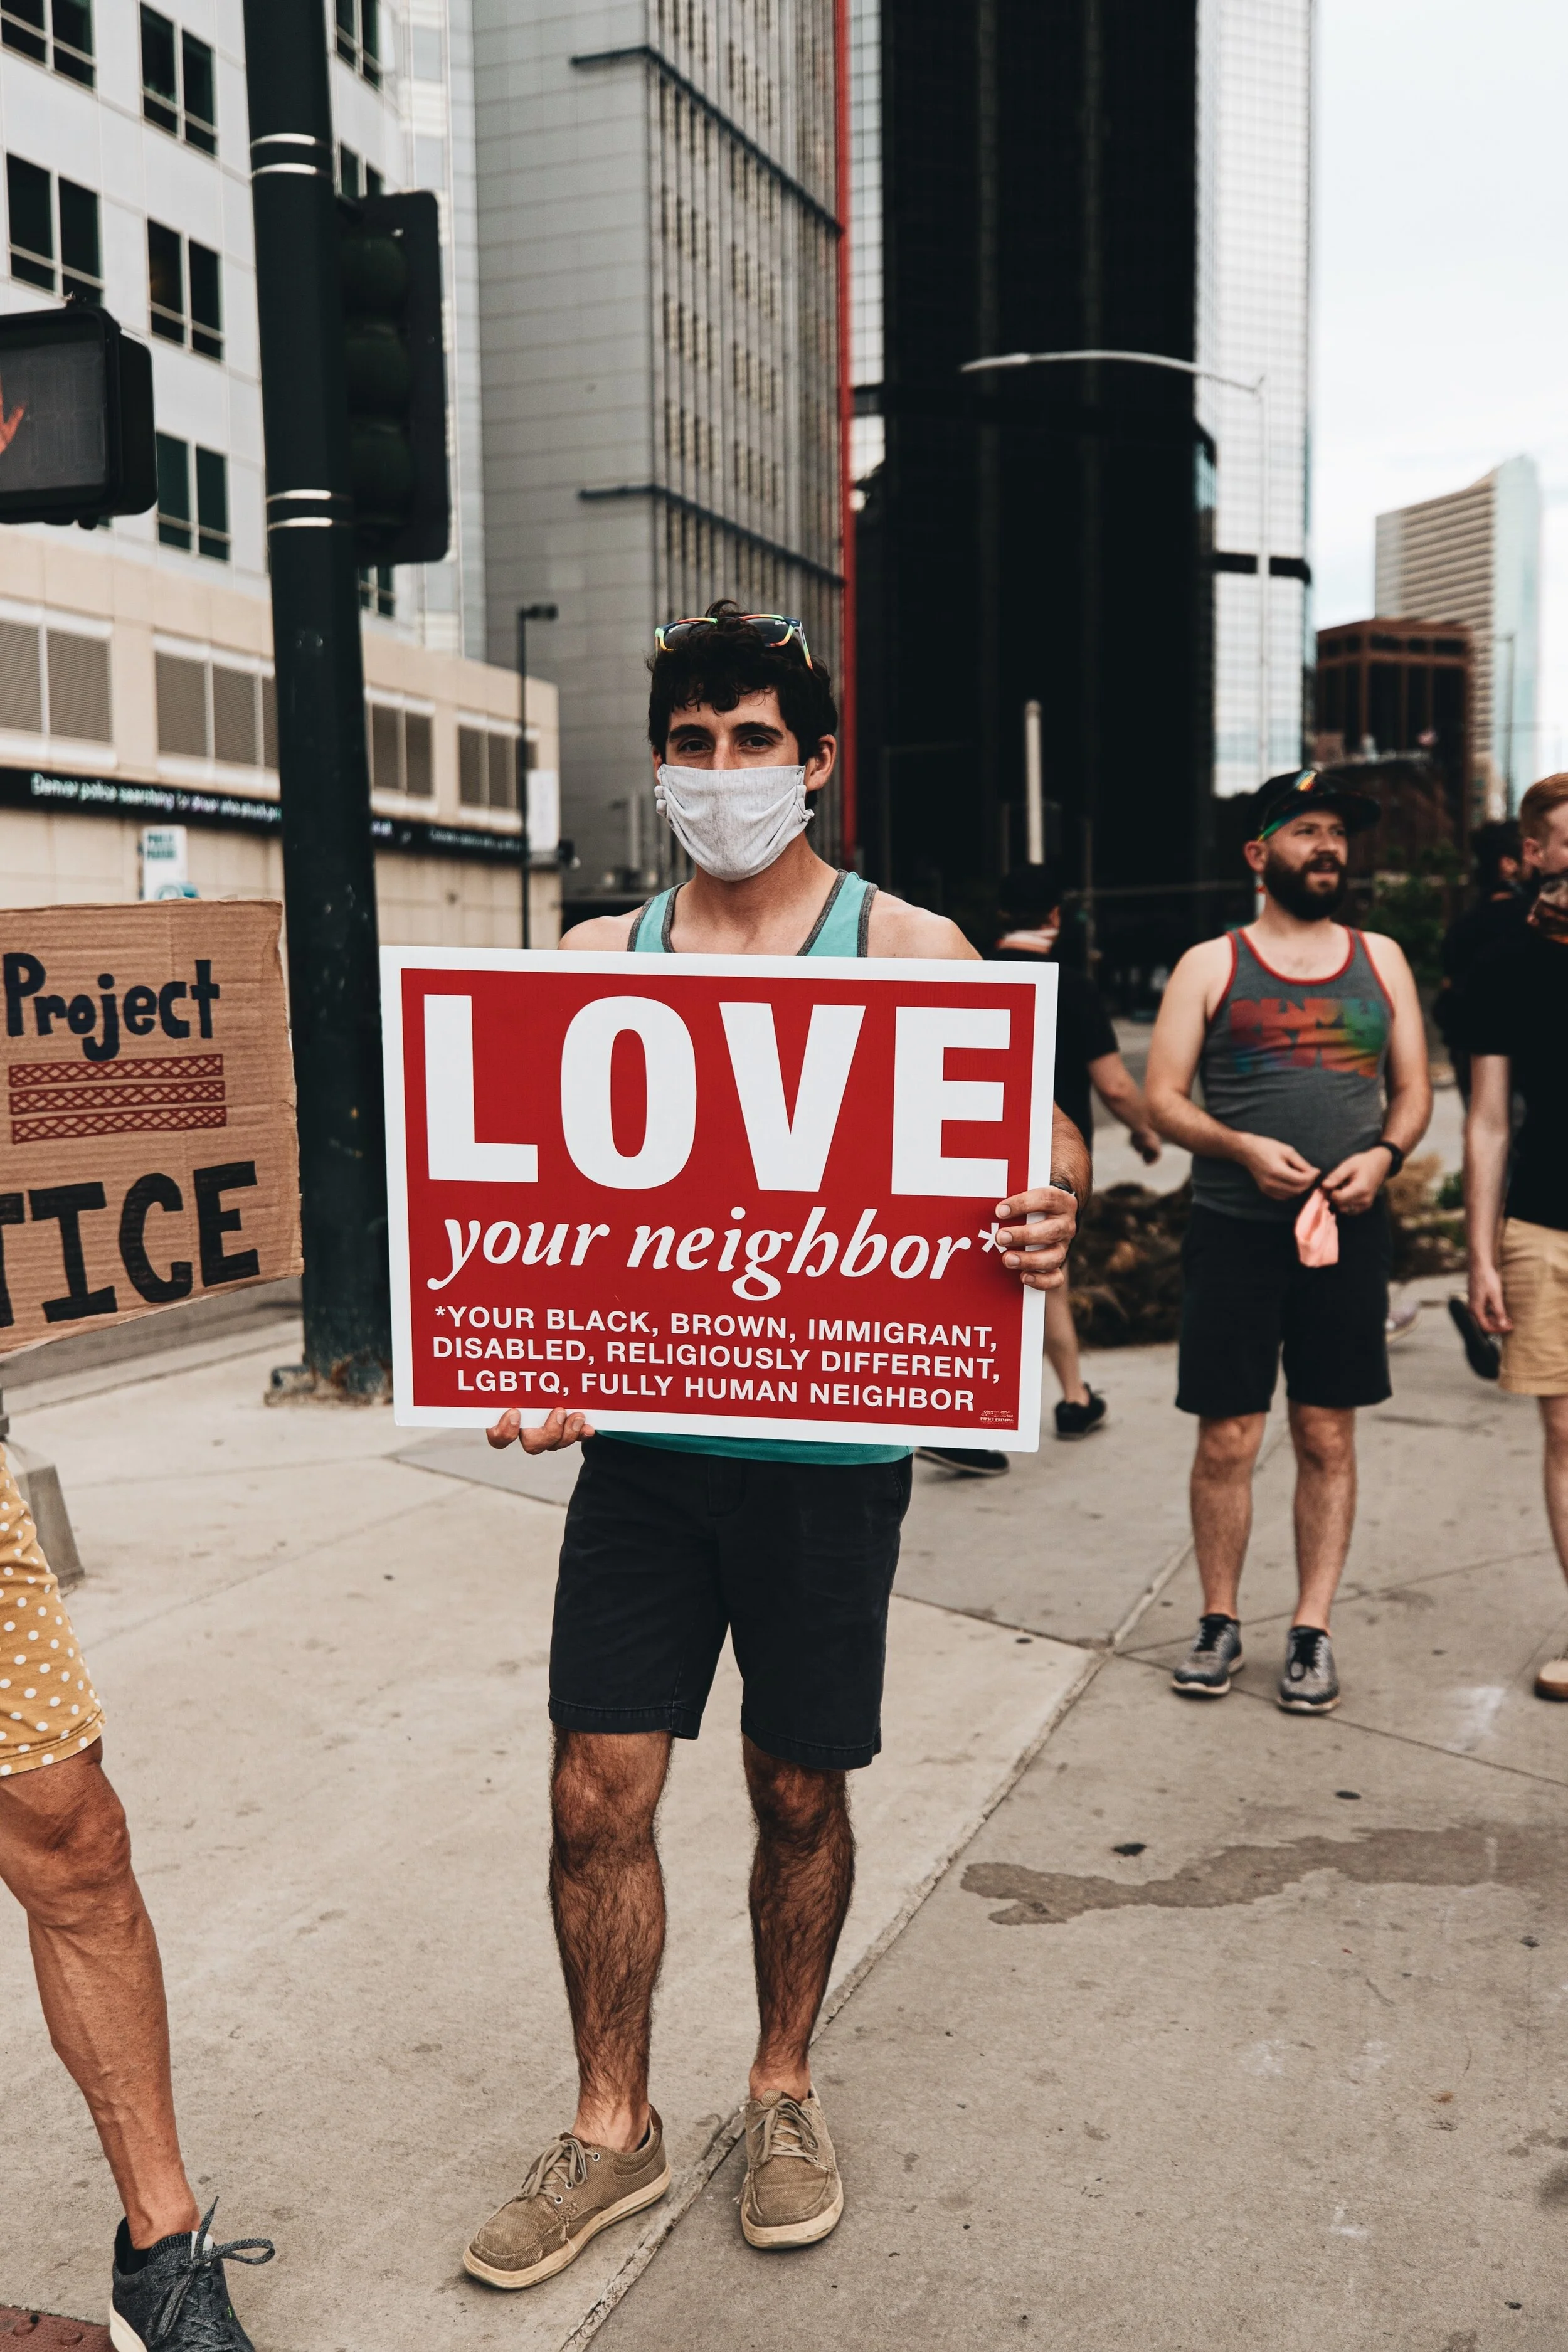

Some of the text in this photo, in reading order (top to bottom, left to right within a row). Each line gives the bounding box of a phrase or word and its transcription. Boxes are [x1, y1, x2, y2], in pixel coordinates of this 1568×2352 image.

[31, 772, 78, 798] Denver
[78, 779, 117, 803] police
[118, 786, 175, 812] searching
[3, 952, 220, 1061] Project
[424, 993, 1012, 1199] LOVE
[427, 1219, 610, 1290] your
[546, 1308, 659, 1337] BLACK,
[671, 1313, 796, 1343] BROWN,
[808, 1318, 997, 1352] IMMIGRANT,
[433, 1337, 999, 1384] DISABLED, RELIGIOUSLY DIFFERENT,
[458, 1370, 974, 1411] LGBTQ, FULLY HUMAN NEIGHBOR
